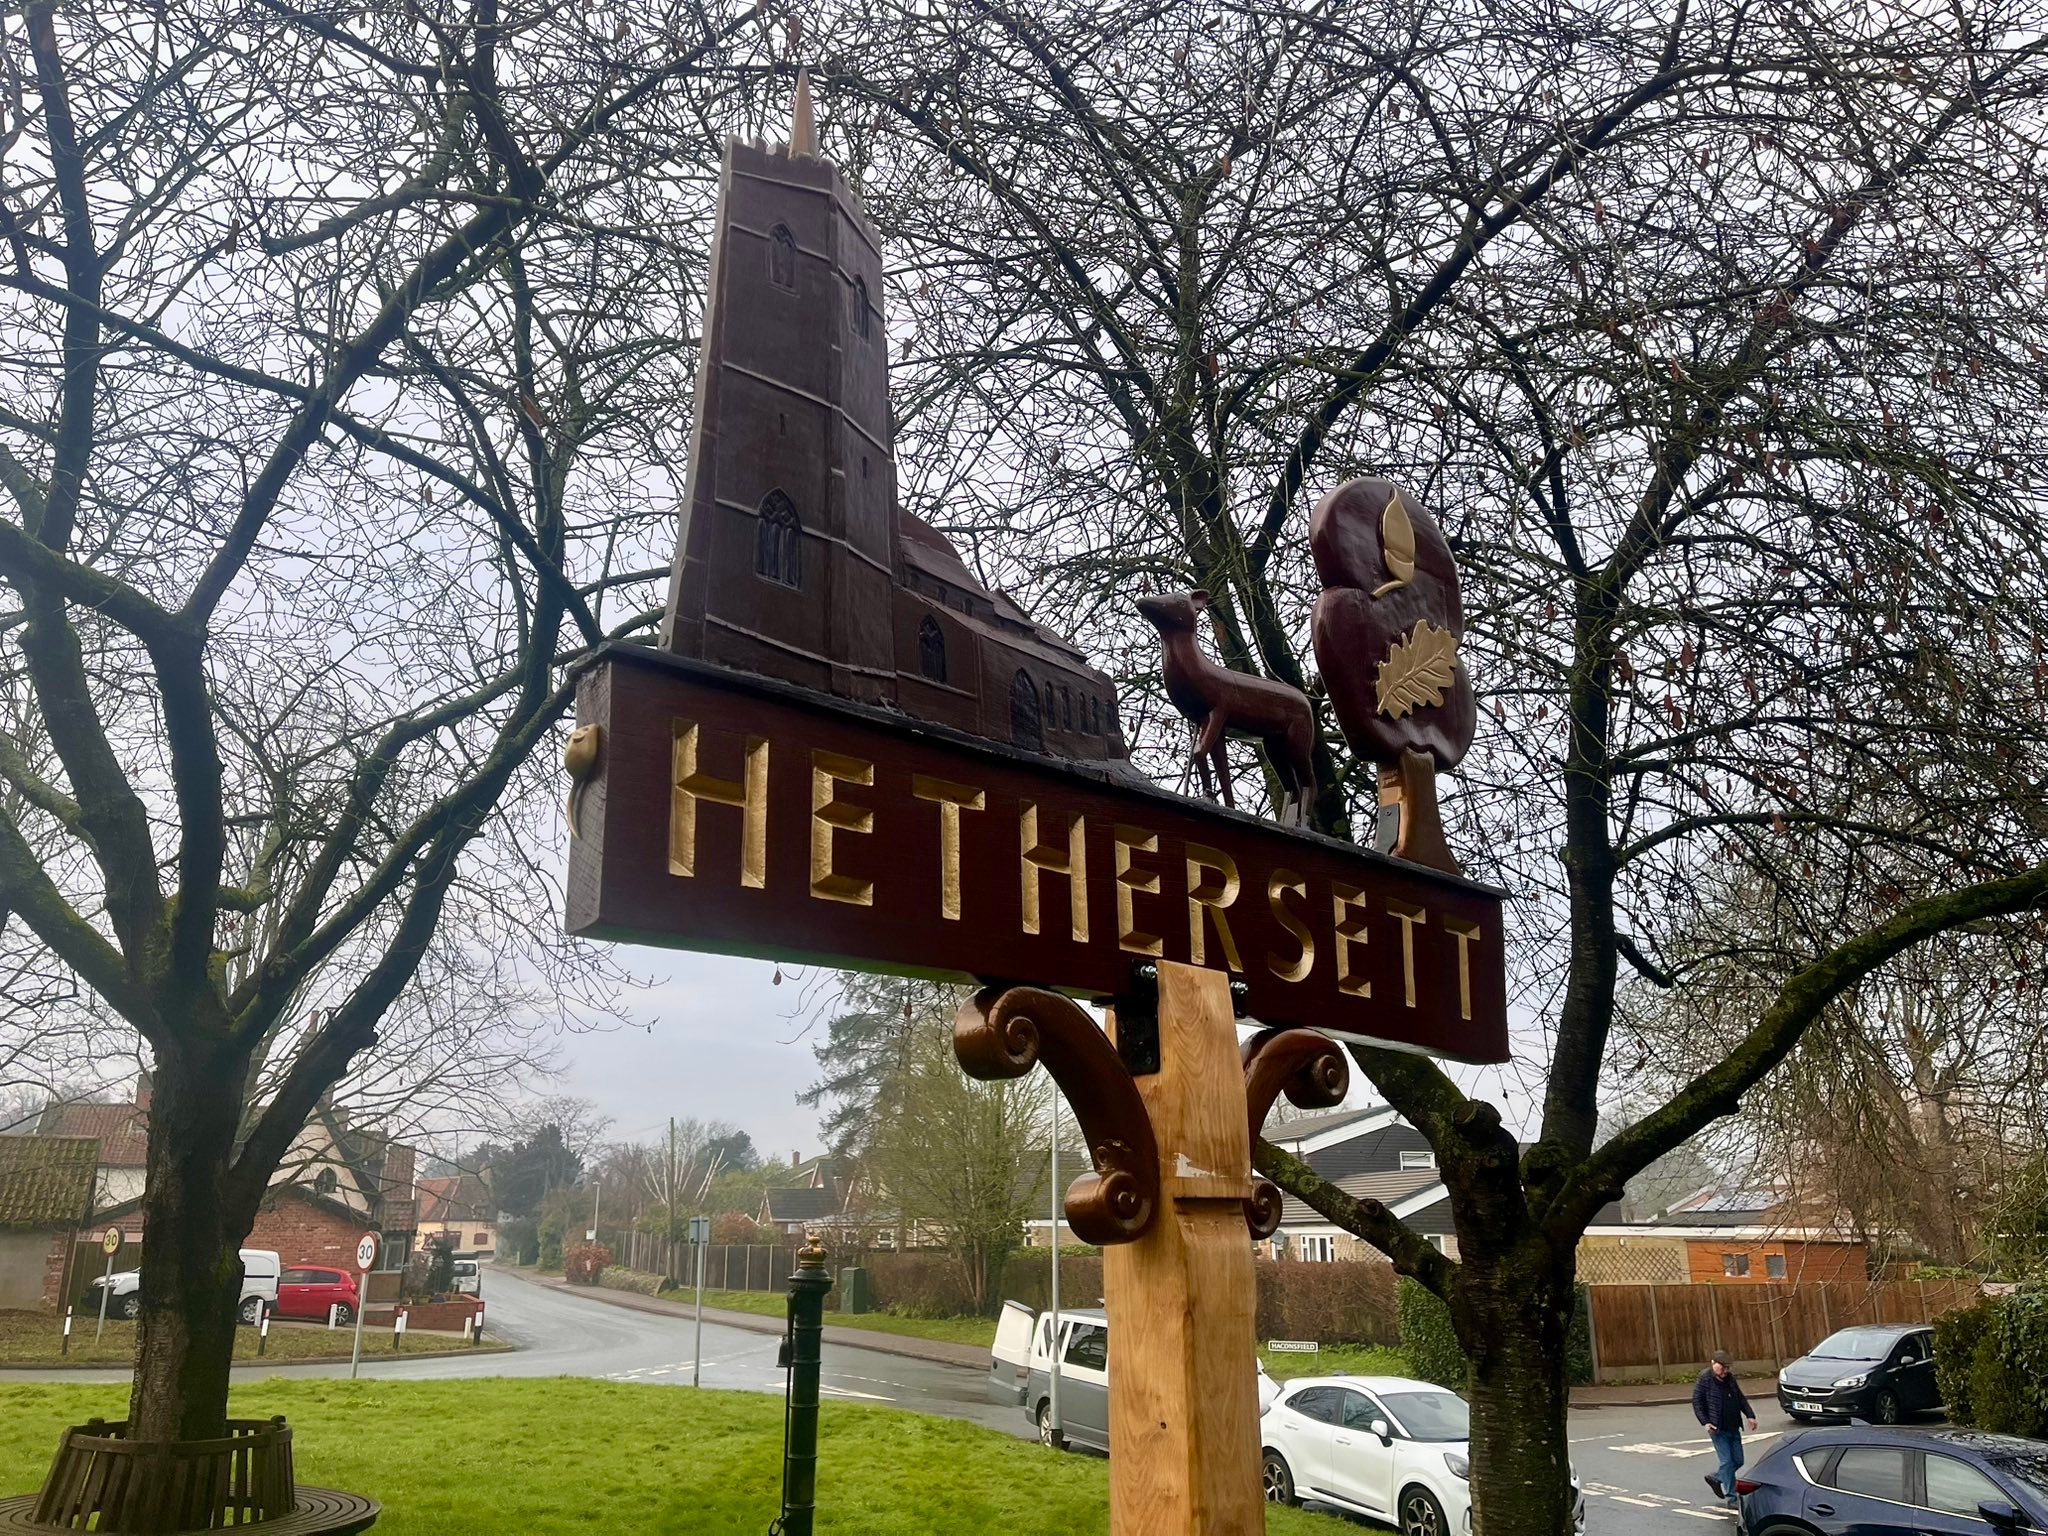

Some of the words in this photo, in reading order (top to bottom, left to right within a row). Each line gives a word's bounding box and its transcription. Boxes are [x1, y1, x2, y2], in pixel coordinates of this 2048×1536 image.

[668, 719, 1481, 1021] HETHERSETT
[105, 1234, 118, 1246] 30
[359, 1244, 373, 1260] 30
[1271, 1342, 1315, 1350] HACONSFIELD
